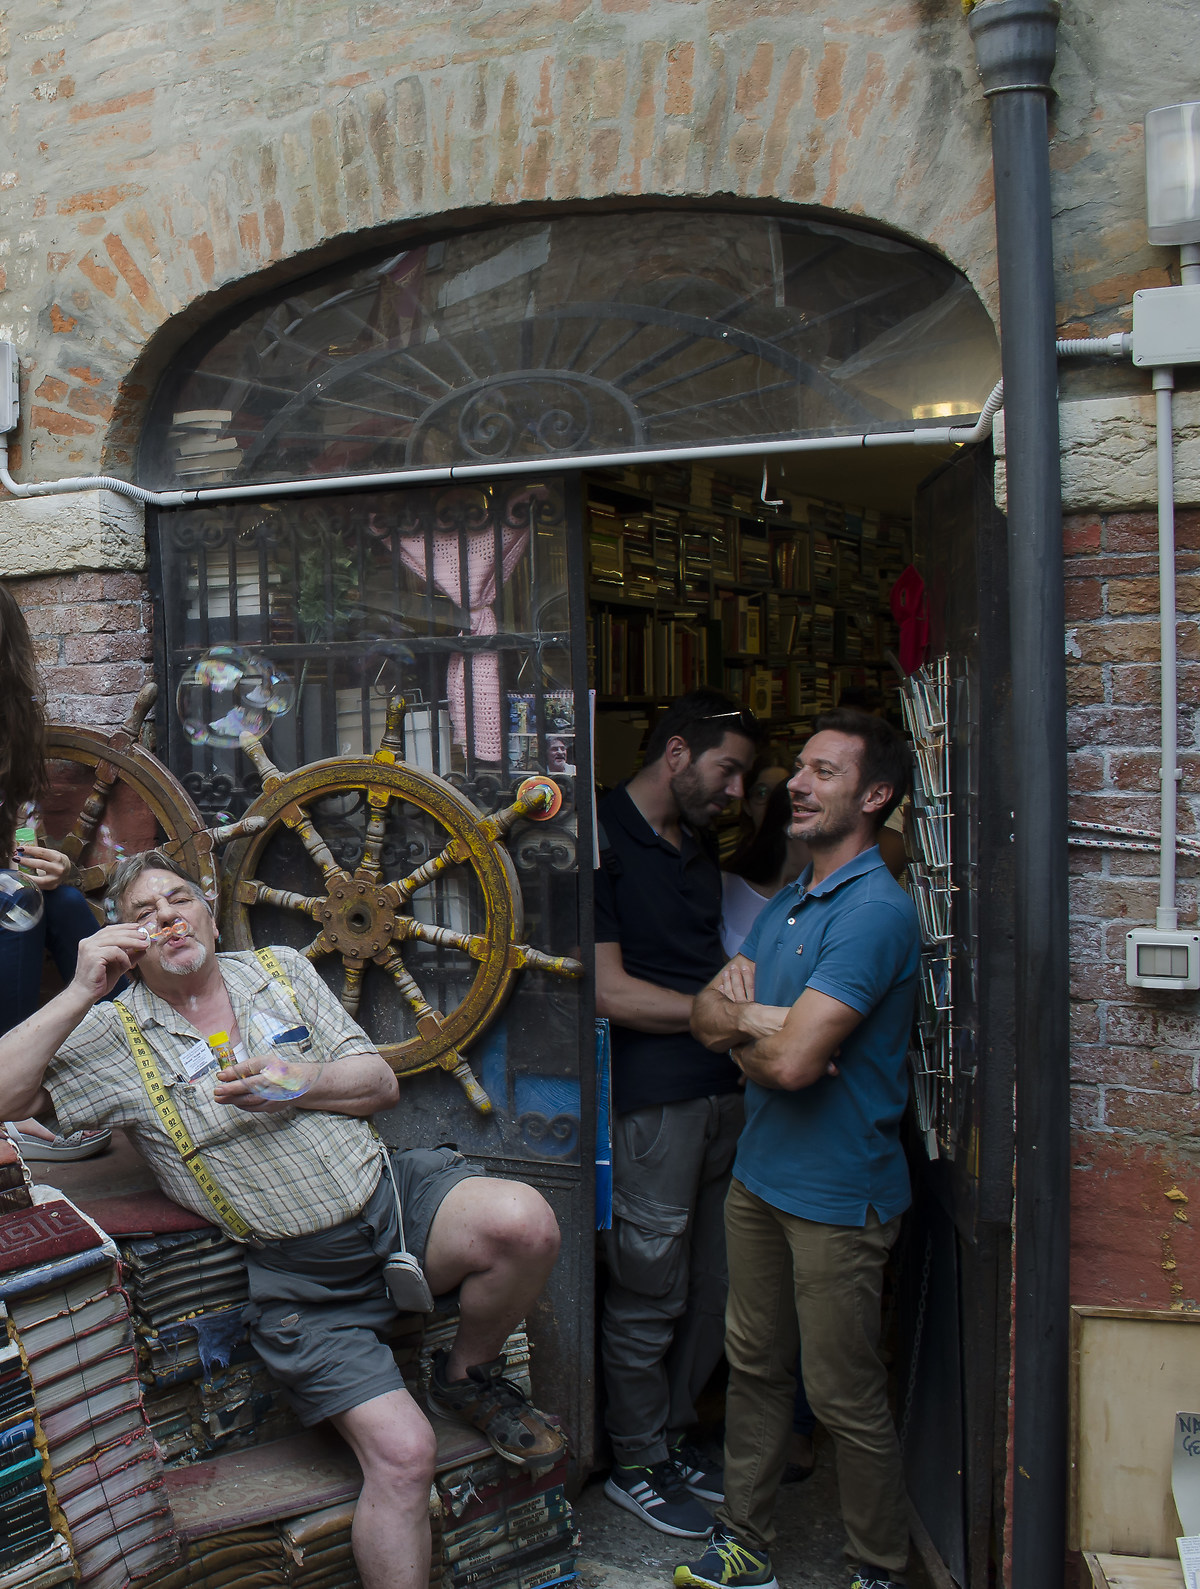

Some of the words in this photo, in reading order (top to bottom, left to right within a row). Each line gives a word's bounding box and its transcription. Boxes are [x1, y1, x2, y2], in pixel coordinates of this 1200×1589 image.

[146, 1071, 155, 1079] 88
[156, 1095, 165, 1103] 90
[162, 1107, 170, 1115] 91
[168, 1118, 176, 1127] 92
[174, 1130, 183, 1138] 93
[181, 1142, 189, 1150] 94
[524, 1568, 557, 1584] DIZIONARIO
